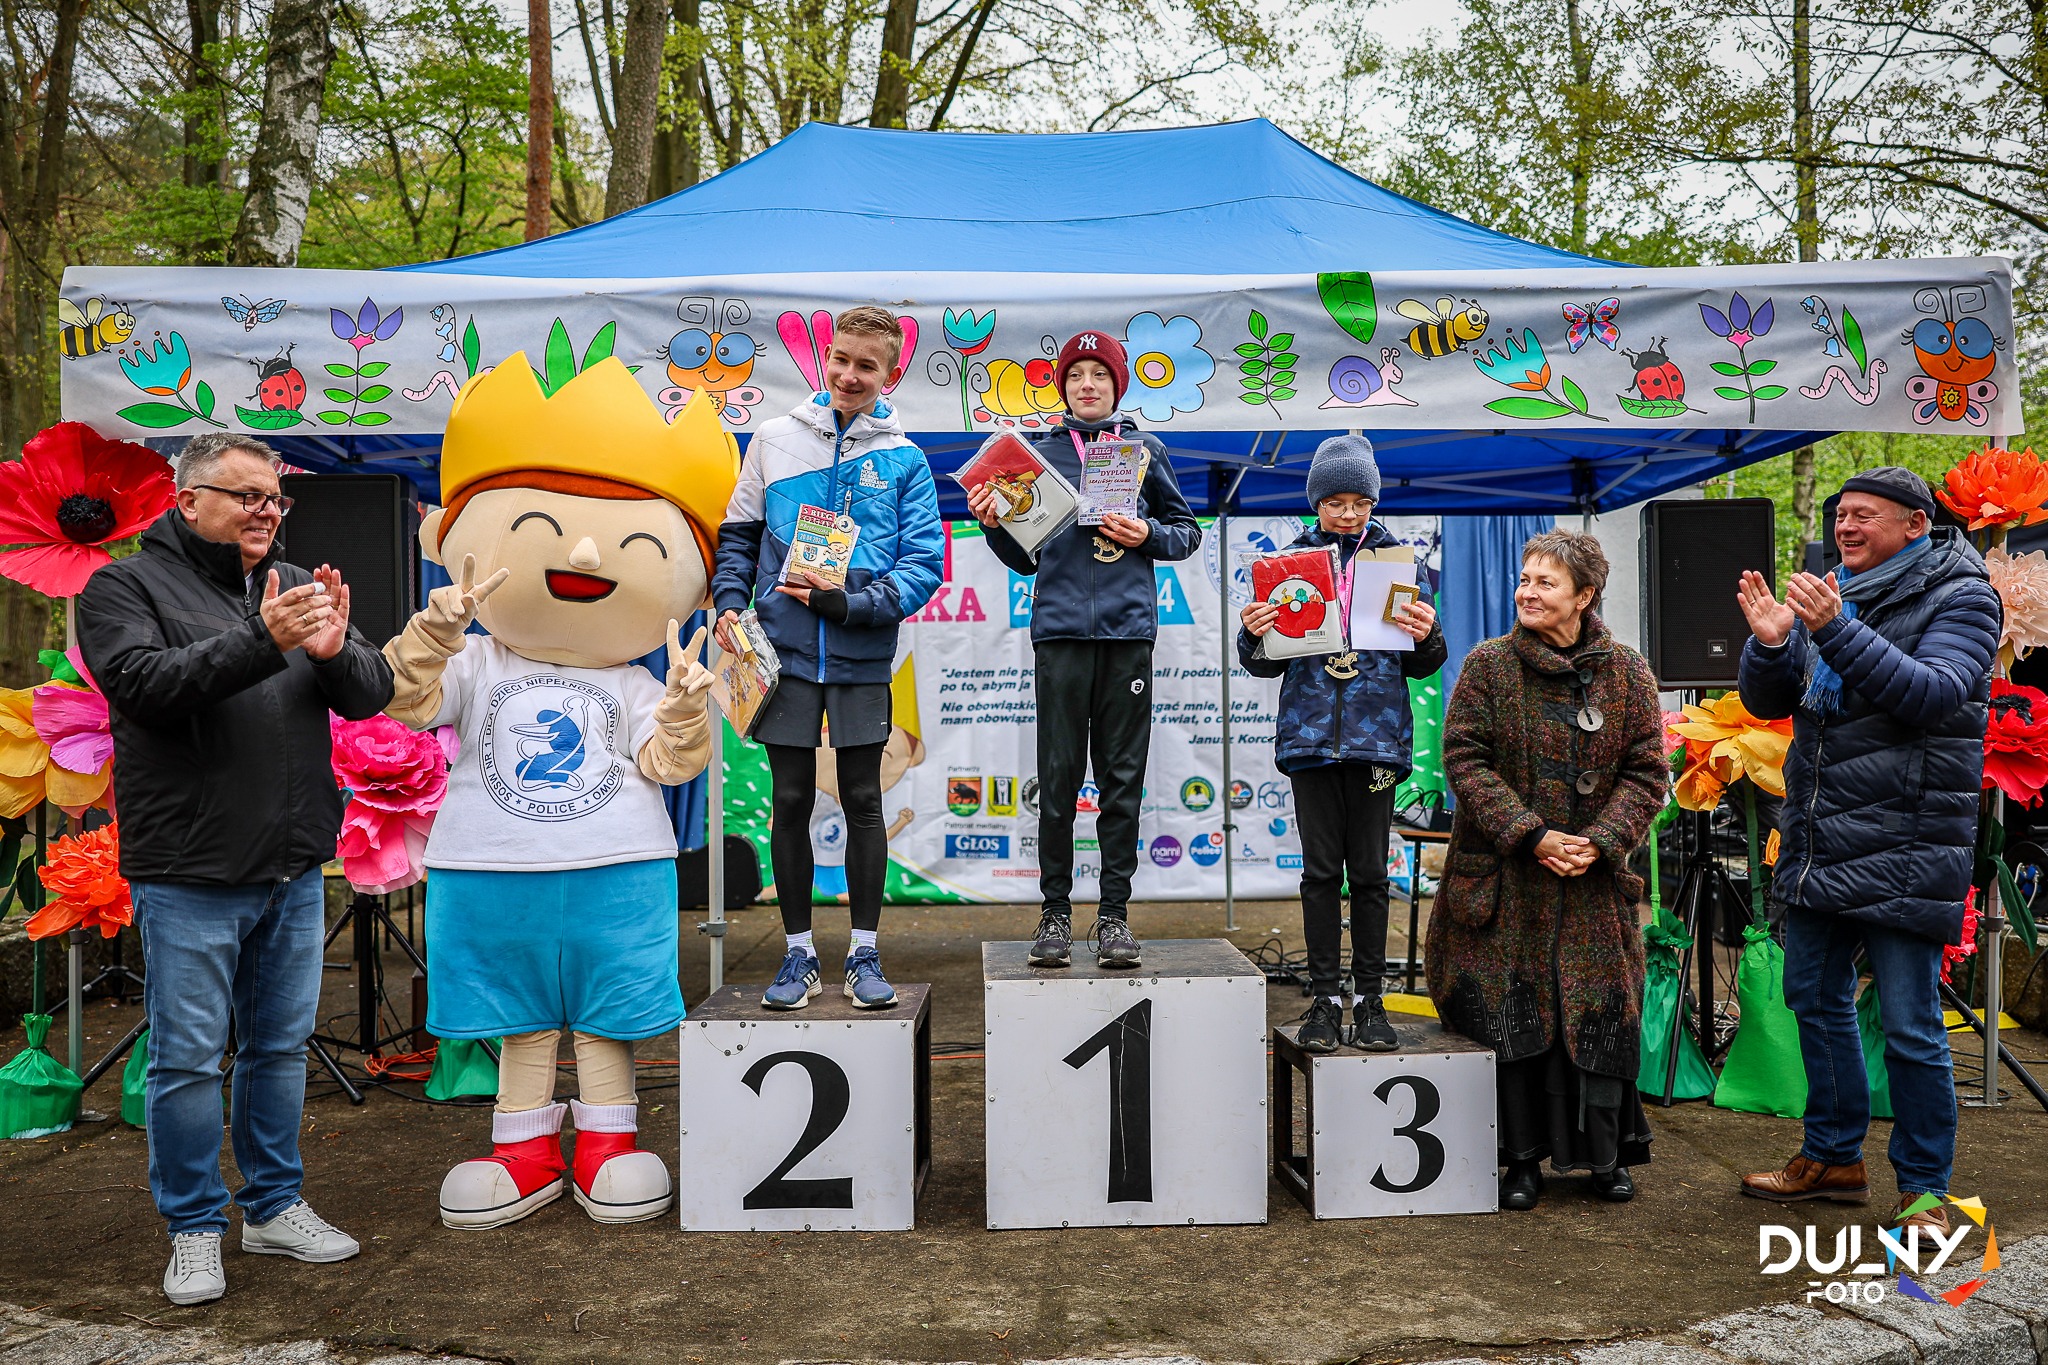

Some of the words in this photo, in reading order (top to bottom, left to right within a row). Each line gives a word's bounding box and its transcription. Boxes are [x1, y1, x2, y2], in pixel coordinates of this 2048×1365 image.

[1101, 469, 1132, 477] DYPLOM
[906, 586, 987, 623] KA
[941, 668, 995, 679] "Jestem
[998, 667, 1018, 676] nie
[1152, 668, 1171, 678] ali
[1174, 668, 1179, 677] i
[490, 684, 522, 708] DZIECI
[940, 683, 957, 694] po
[961, 682, 977, 693] to,
[982, 681, 1016, 692] abym
[1018, 680, 1031, 692] ja
[941, 702, 963, 712] Nie
[1184, 701, 1218, 712] mnie,
[1228, 701, 1242, 711] le
[1245, 701, 1258, 712] ja
[485, 712, 494, 737] DLA
[941, 717, 972, 726] mam
[1160, 714, 1199, 725] świat,
[1204, 716, 1212, 724] o
[1216, 714, 1277, 724] cłowiek
[484, 752, 494, 769] NR
[488, 773, 513, 802] SOSW
[592, 762, 622, 801] CHOWO
[527, 802, 577, 815] POLICE
[955, 835, 1000, 851] GŁOS
[1062, 997, 1154, 1204] 1
[741, 1050, 855, 1211] 2
[1370, 1074, 1446, 1194] 3
